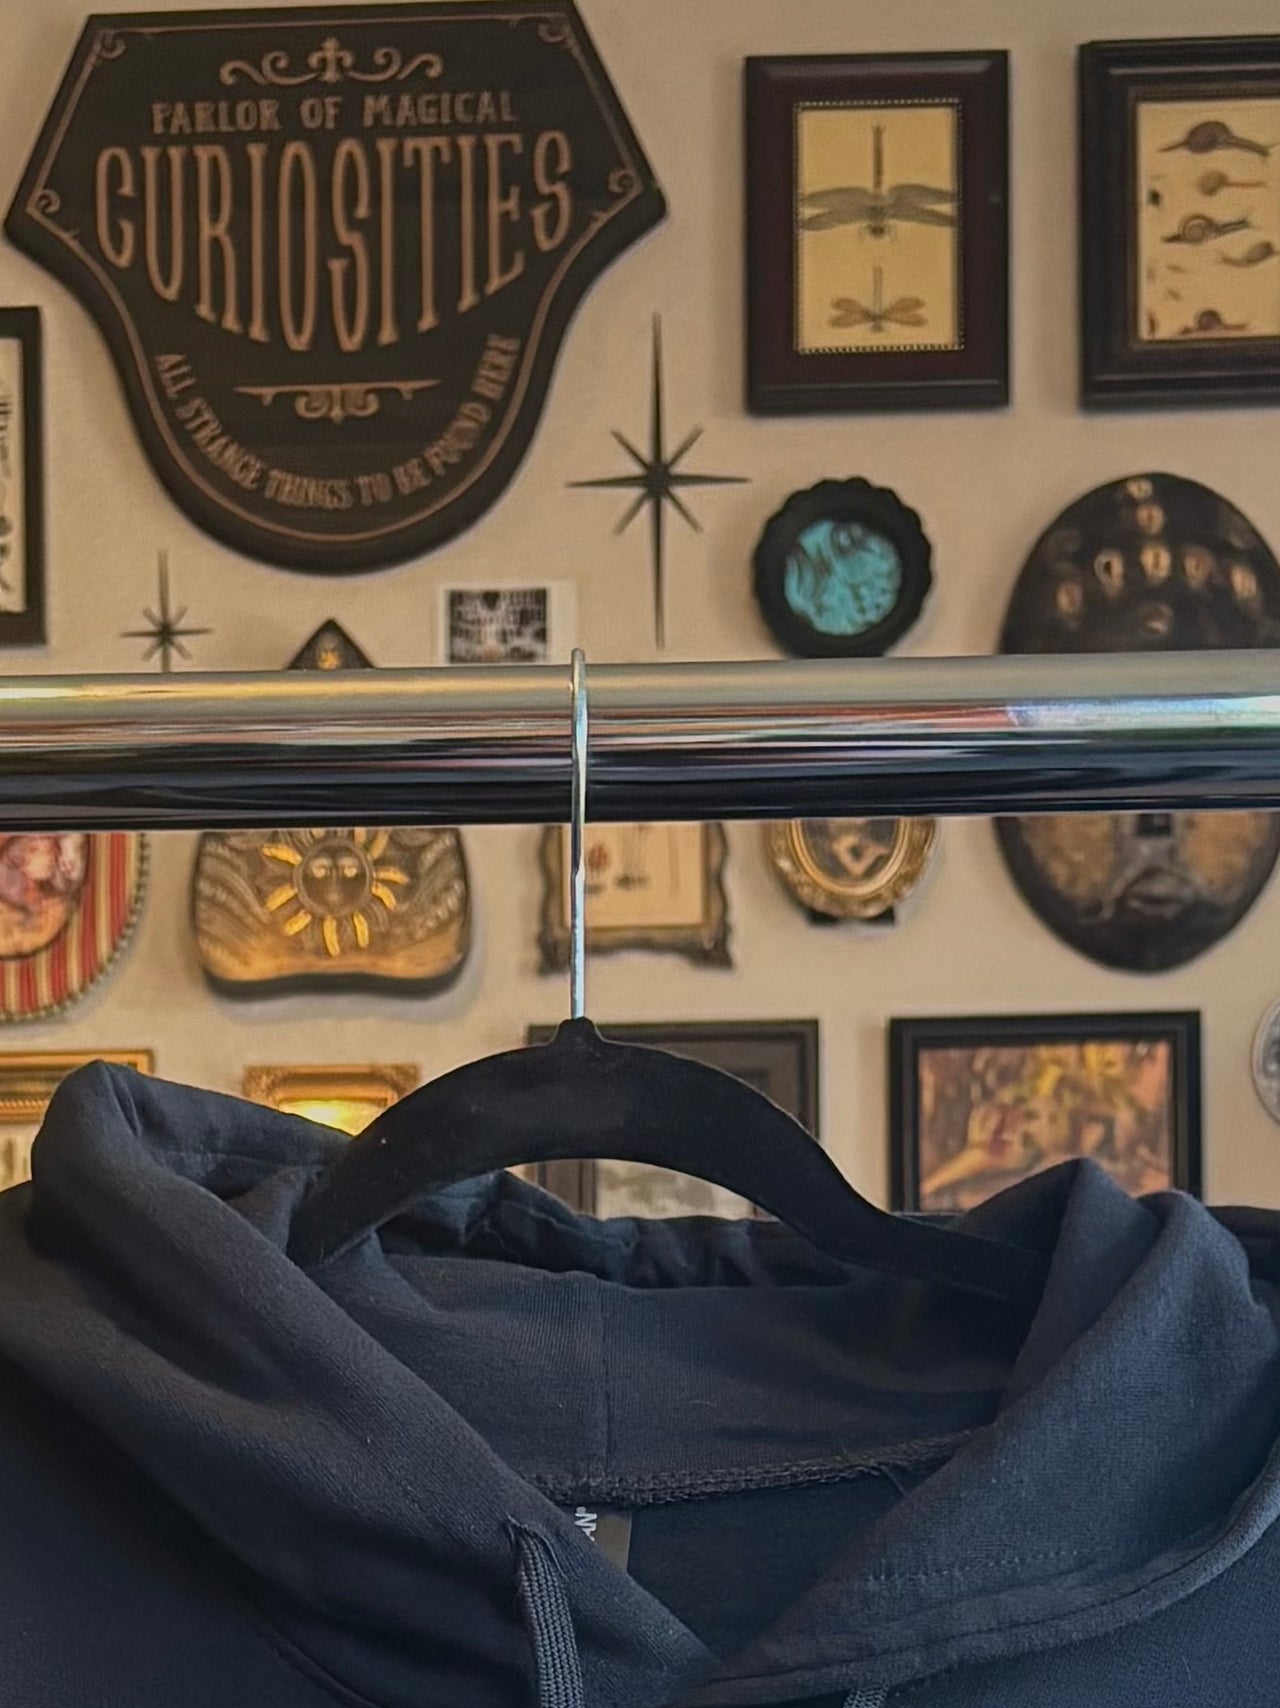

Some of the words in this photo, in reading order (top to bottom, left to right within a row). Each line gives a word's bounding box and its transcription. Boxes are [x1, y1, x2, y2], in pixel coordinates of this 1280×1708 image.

[152, 98, 281, 135] PARLOR
[301, 95, 342, 130] OF
[362, 90, 519, 127] MAGICAL
[95, 130, 575, 352] CURIOSITIES
[155, 353, 196, 399] ALL
[472, 333, 520, 401] HERE
[174, 397, 269, 490] STRANGE
[423, 401, 493, 477] FOUND
[265, 468, 354, 510] THINGS
[354, 471, 394, 508] TO
[392, 457, 433, 496] BE
